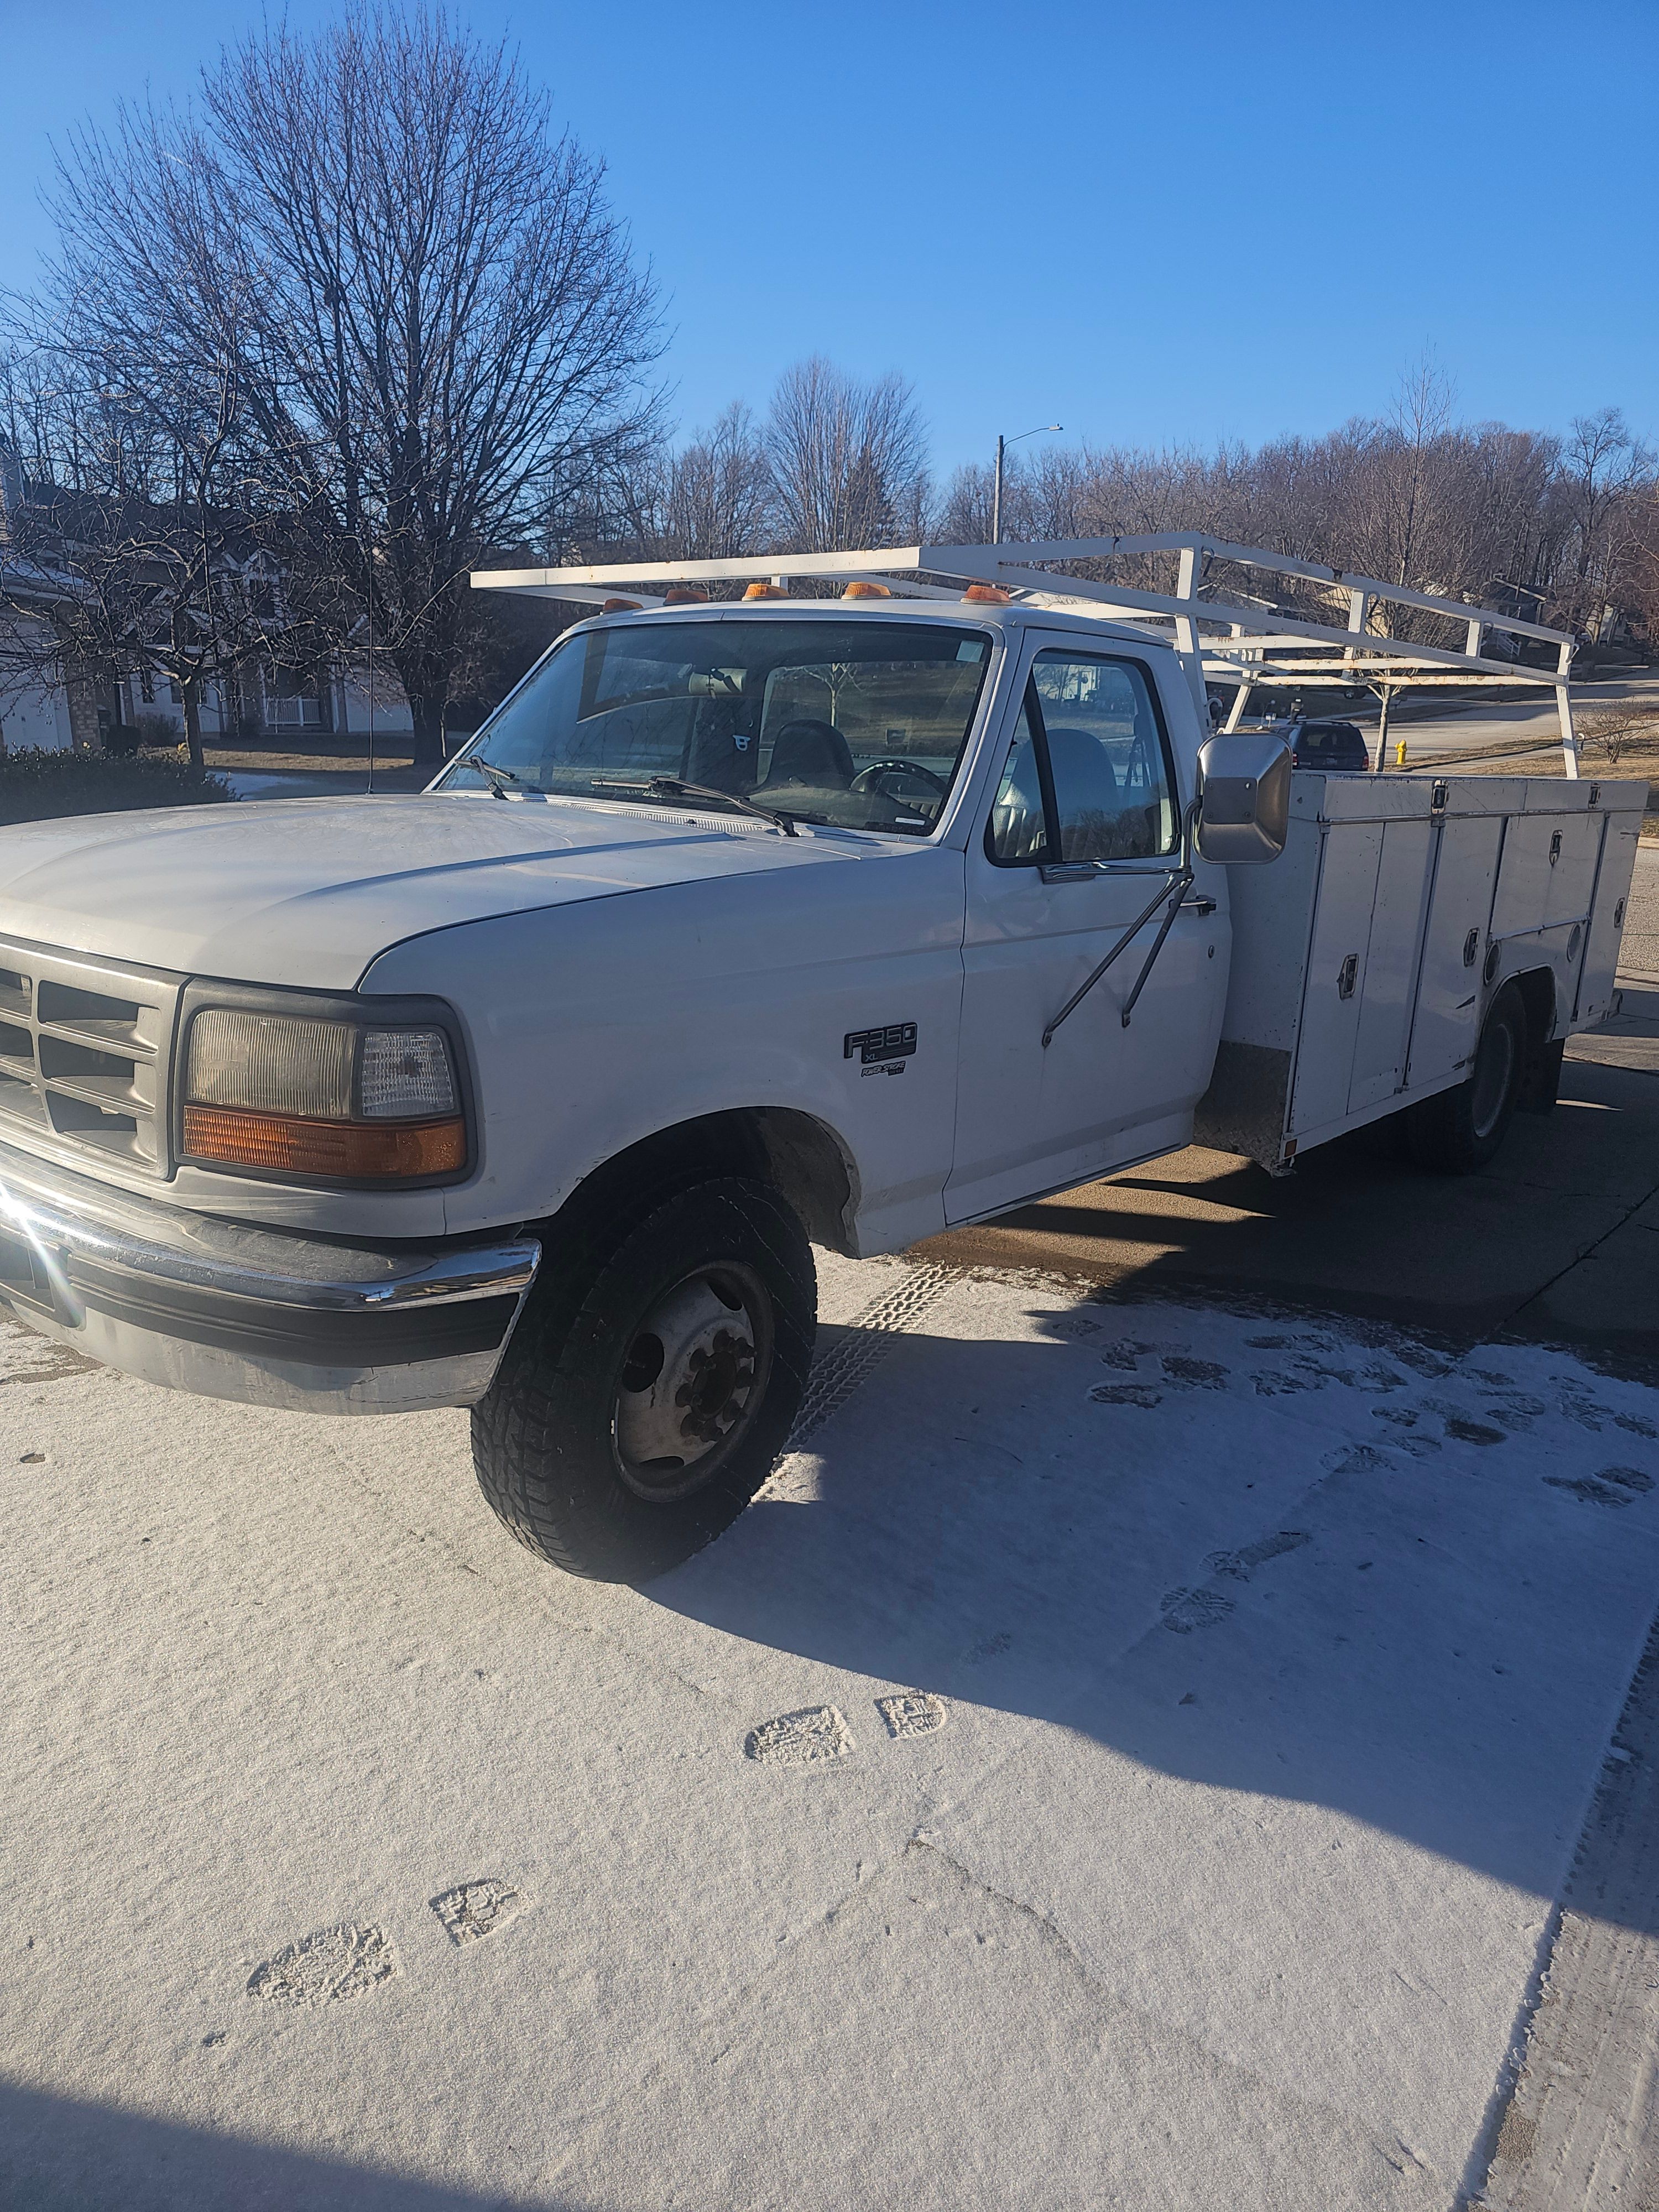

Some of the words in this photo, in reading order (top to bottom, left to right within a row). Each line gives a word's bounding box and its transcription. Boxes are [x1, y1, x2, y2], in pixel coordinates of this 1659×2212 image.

[865, 1053, 878, 1062] XL
[862, 1066, 881, 1076] POWER
[882, 1062, 905, 1072] STROKE
